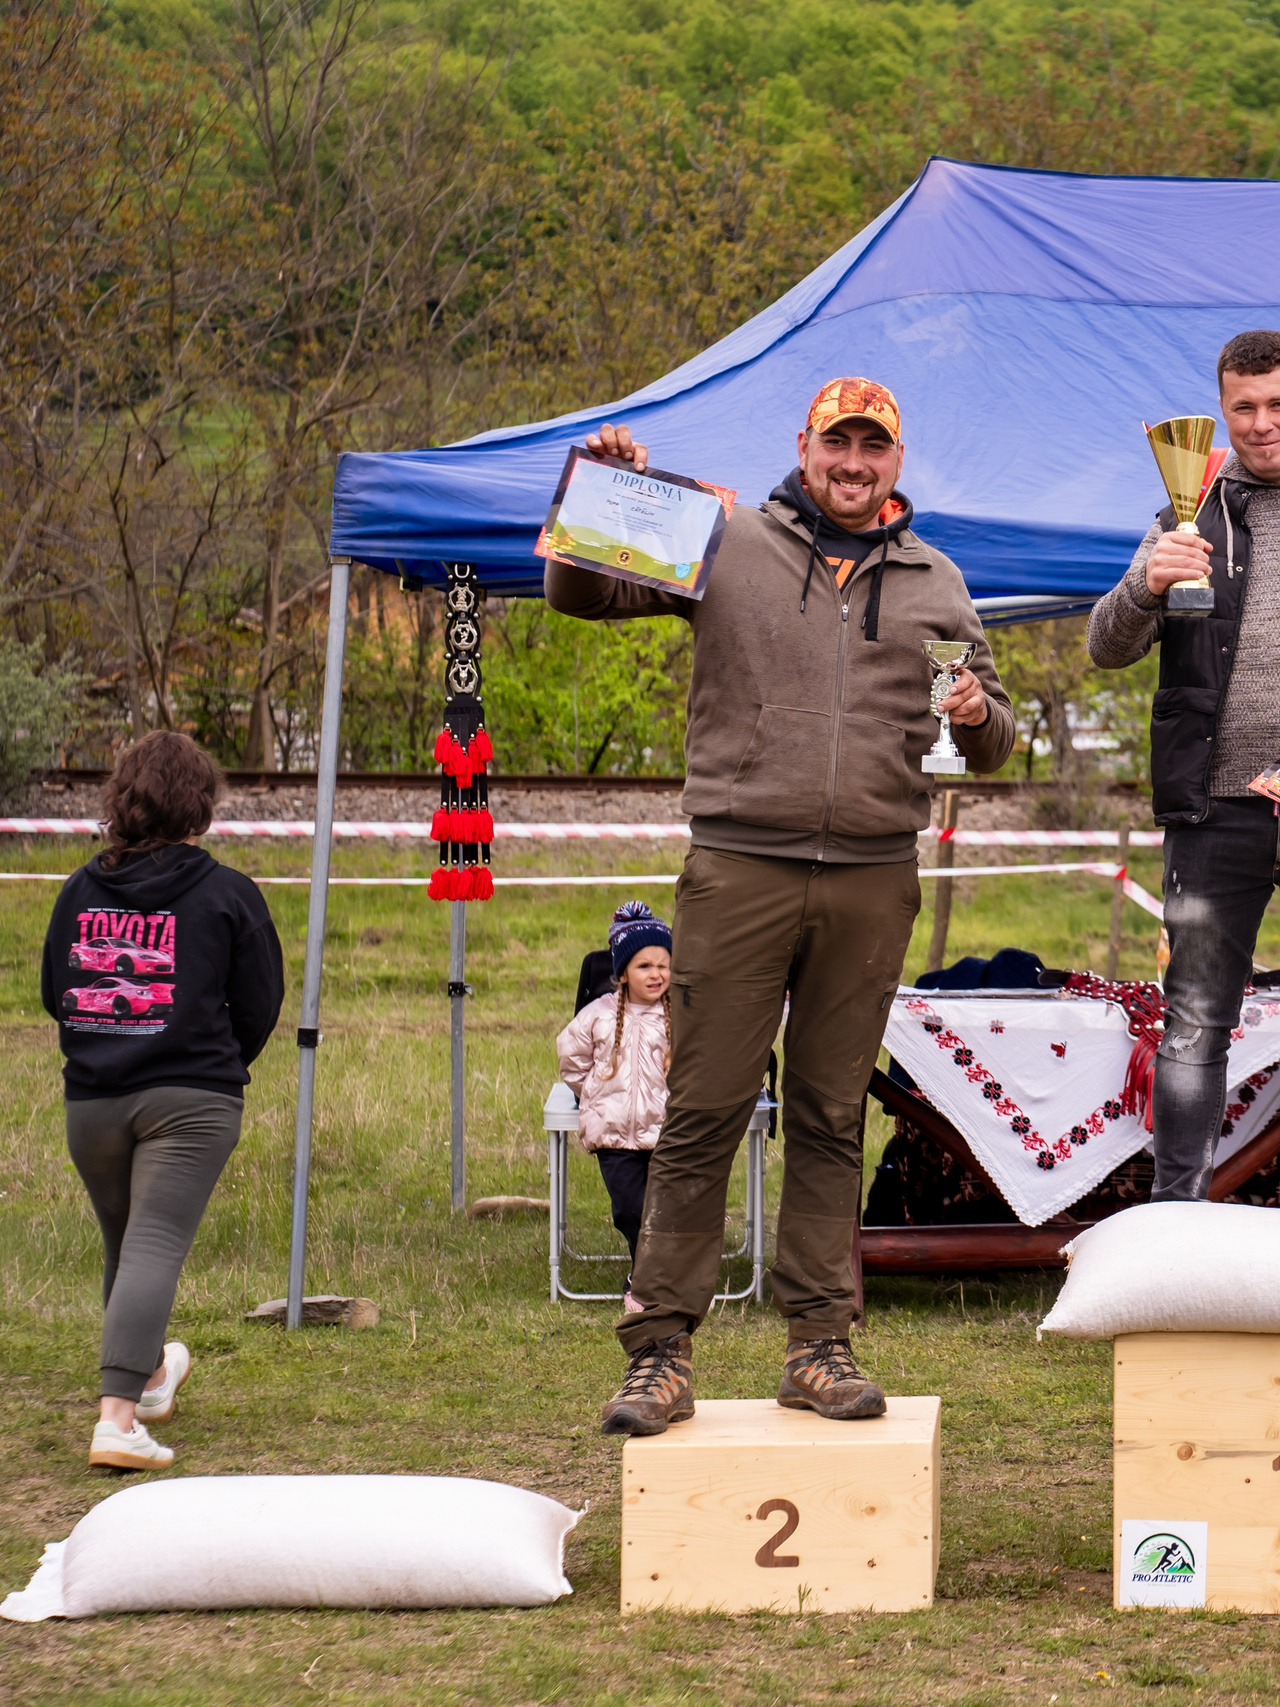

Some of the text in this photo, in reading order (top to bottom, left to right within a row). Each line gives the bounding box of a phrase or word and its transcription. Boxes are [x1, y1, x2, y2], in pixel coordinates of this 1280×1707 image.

[612, 472, 682, 502] DIPLOMĂ
[77, 912, 176, 962] TOYOTA
[68, 1015, 96, 1023] TOYOTA
[755, 1498, 800, 1568] 2
[1132, 1573, 1194, 1583] PRO ATLETIC
